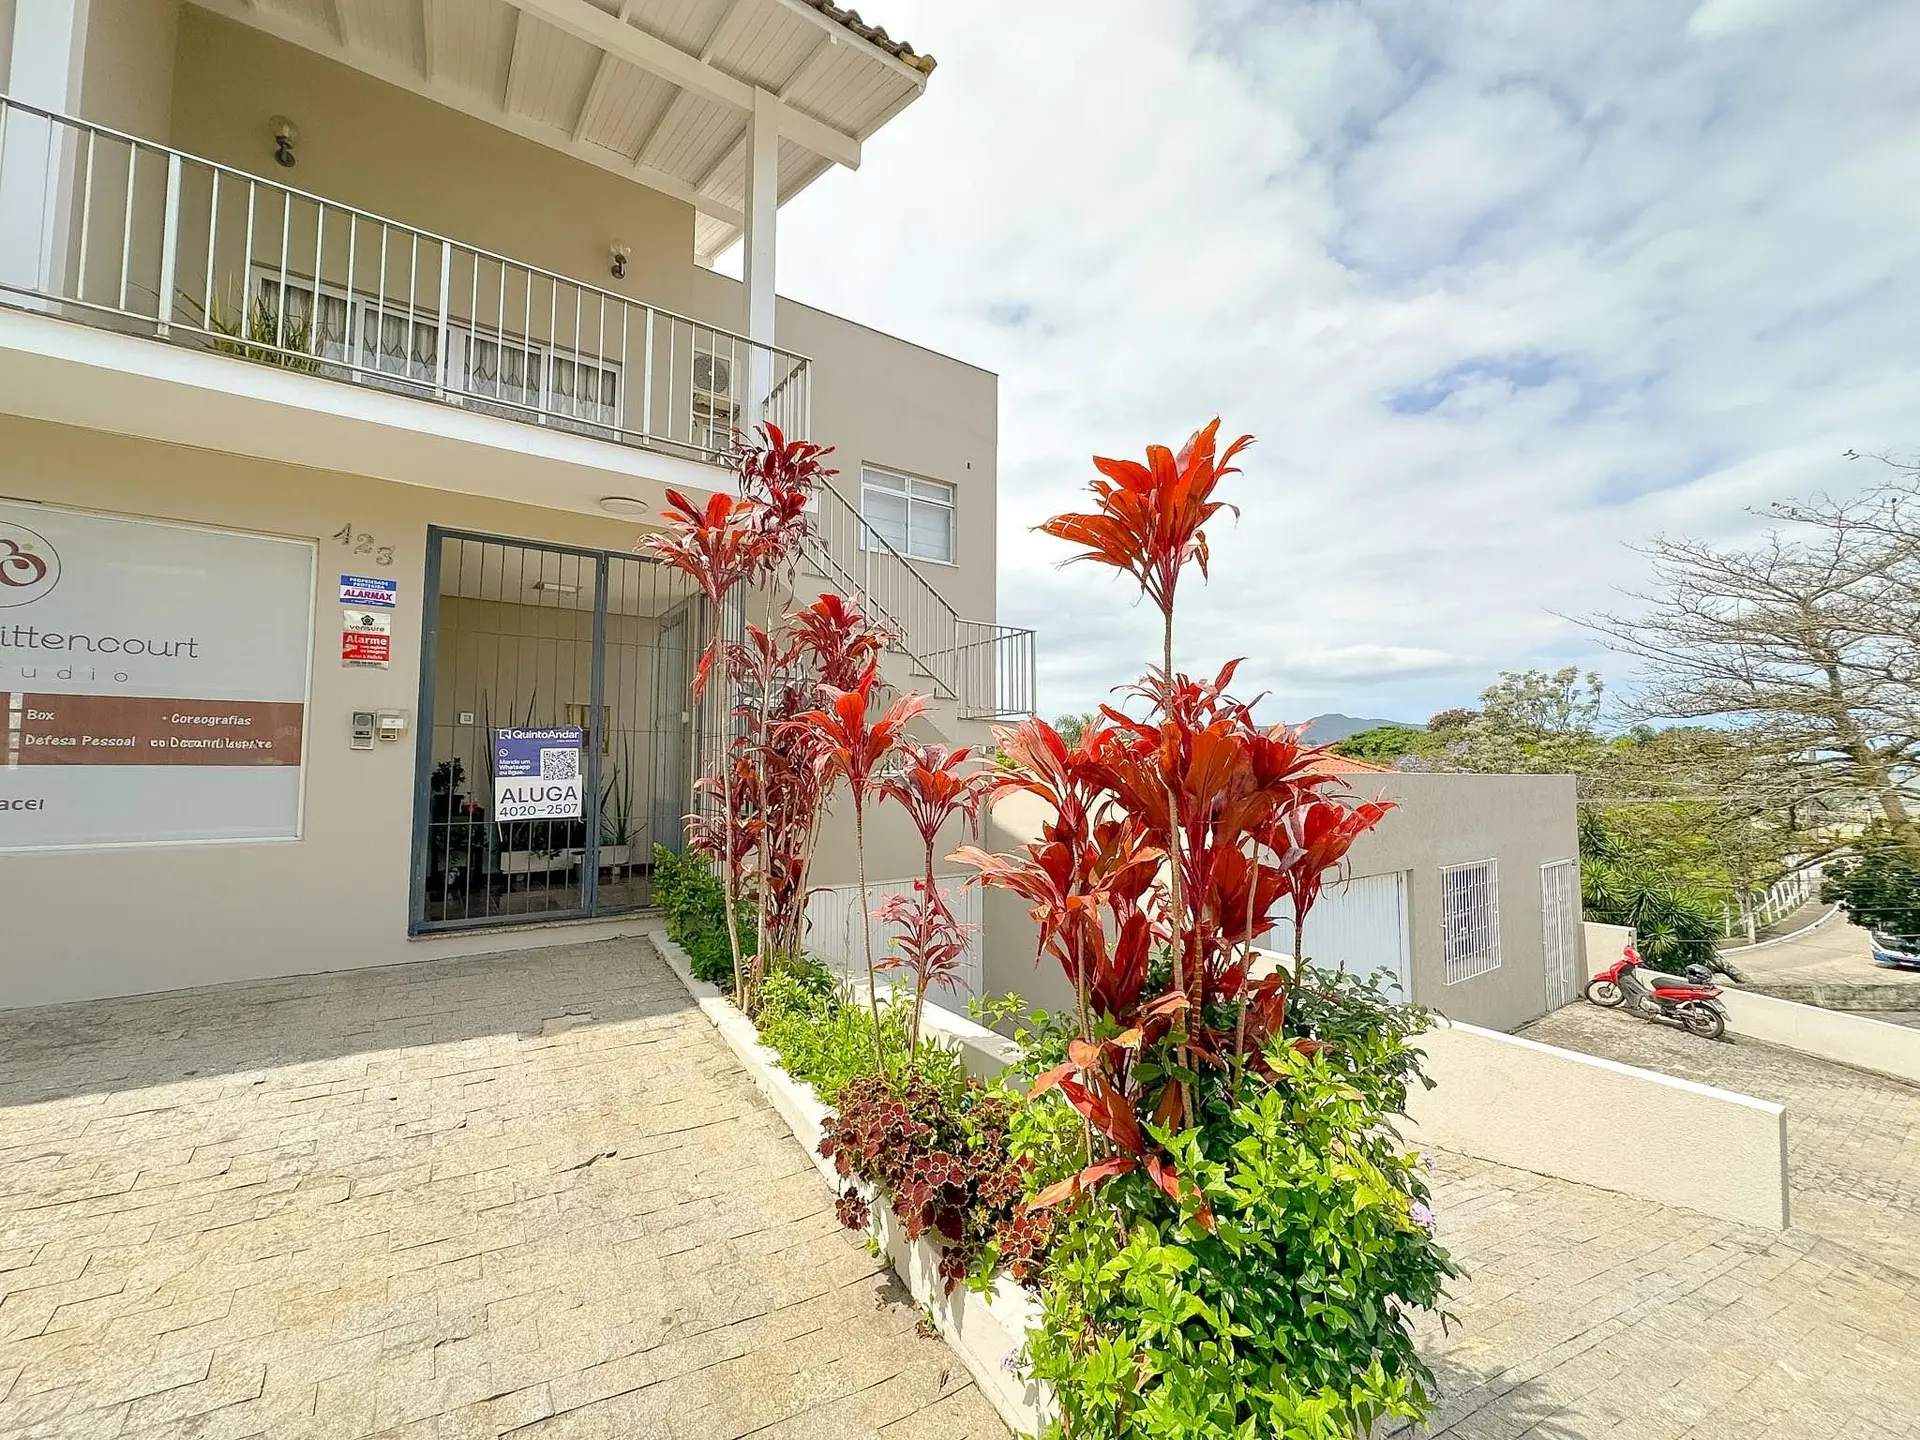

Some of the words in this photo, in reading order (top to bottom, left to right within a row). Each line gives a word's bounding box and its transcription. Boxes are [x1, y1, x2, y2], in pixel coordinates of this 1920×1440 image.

[343, 589, 393, 601] ALARMAX
[0, 625, 199, 658] ittencourt
[346, 634, 387, 645] Alarme
[0, 664, 129, 683] udio
[26, 709, 54, 720] Box
[171, 713, 252, 727] Coreografias
[25, 734, 76, 746] Defesa
[82, 735, 136, 747] Pessoal
[512, 730, 579, 739] QuintoAndar
[500, 786, 578, 804] ALUGA
